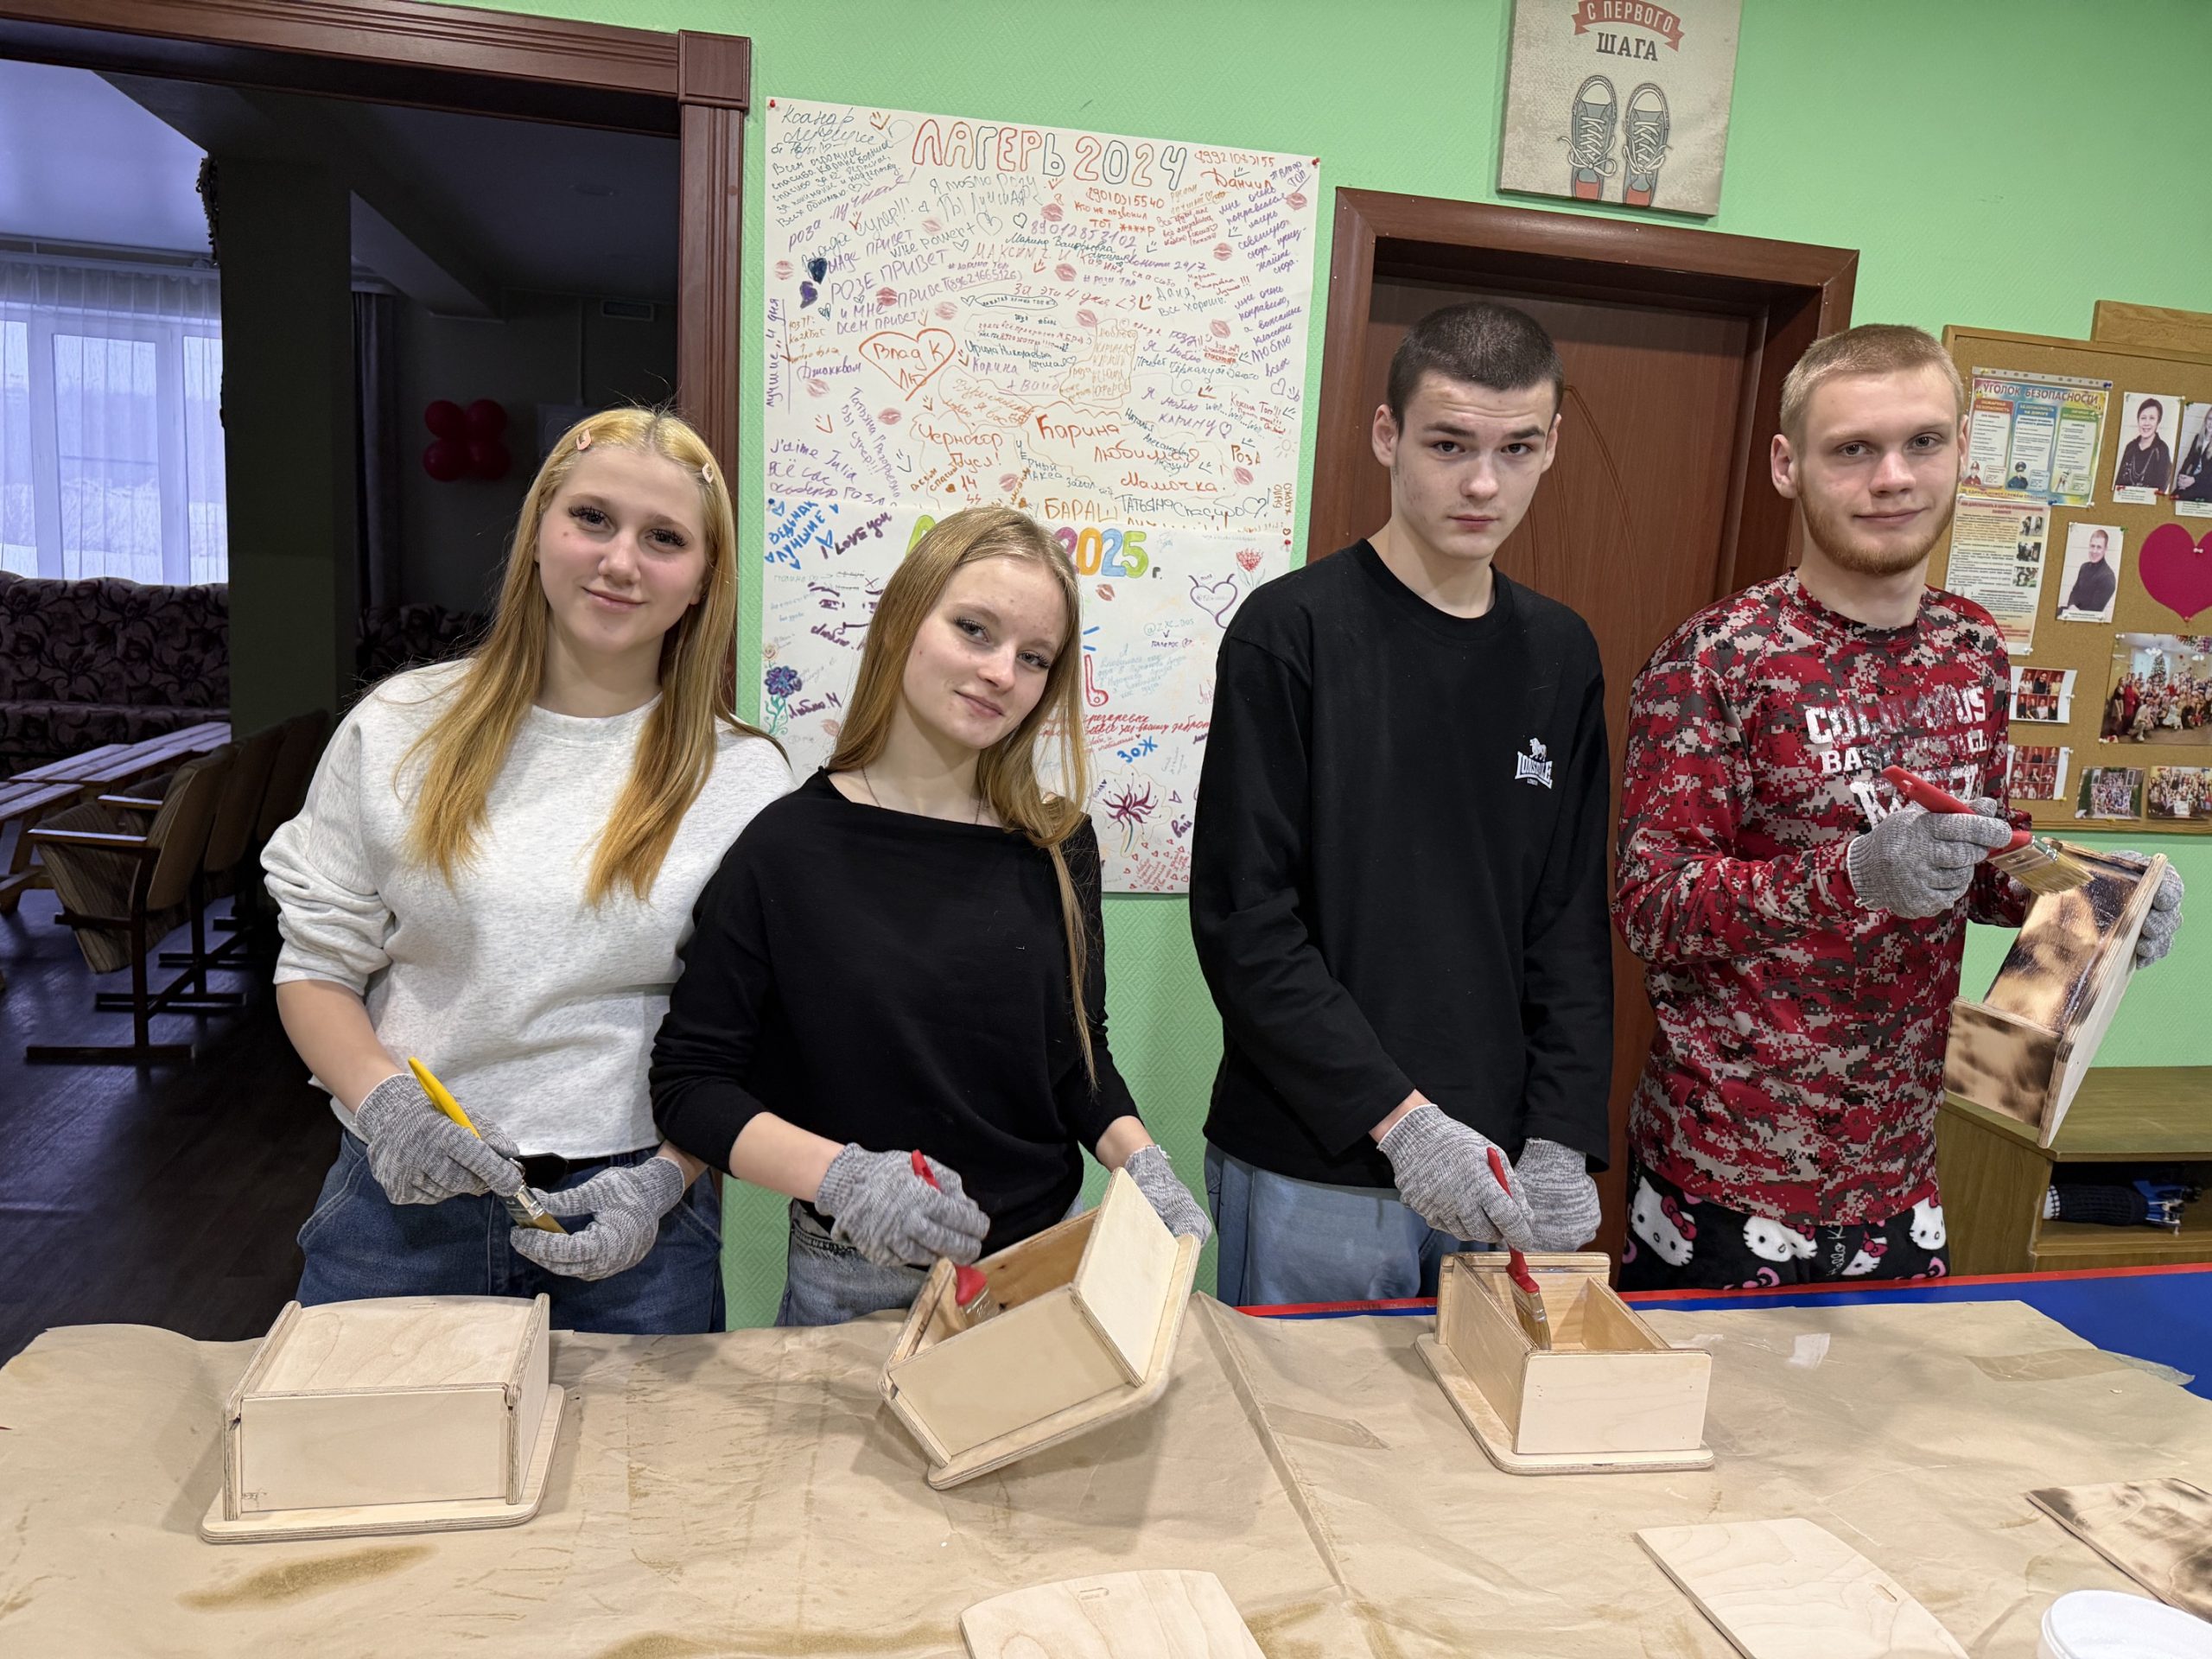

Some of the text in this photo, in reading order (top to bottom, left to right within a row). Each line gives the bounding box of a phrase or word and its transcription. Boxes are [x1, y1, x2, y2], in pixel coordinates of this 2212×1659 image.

[1586, 0, 1674, 33] С ПЕРВОГО
[1596, 32, 1658, 61] ШАГА
[912, 118, 1187, 192] ЛАГЕРЬ 2024
[874, 342, 927, 371] Влад
[1983, 383, 2099, 404] УГОЛОК БЕЗОПАСНОСТИ
[1044, 498, 1118, 523] БАРАШ
[1116, 736, 1159, 763] ЗОЖ
